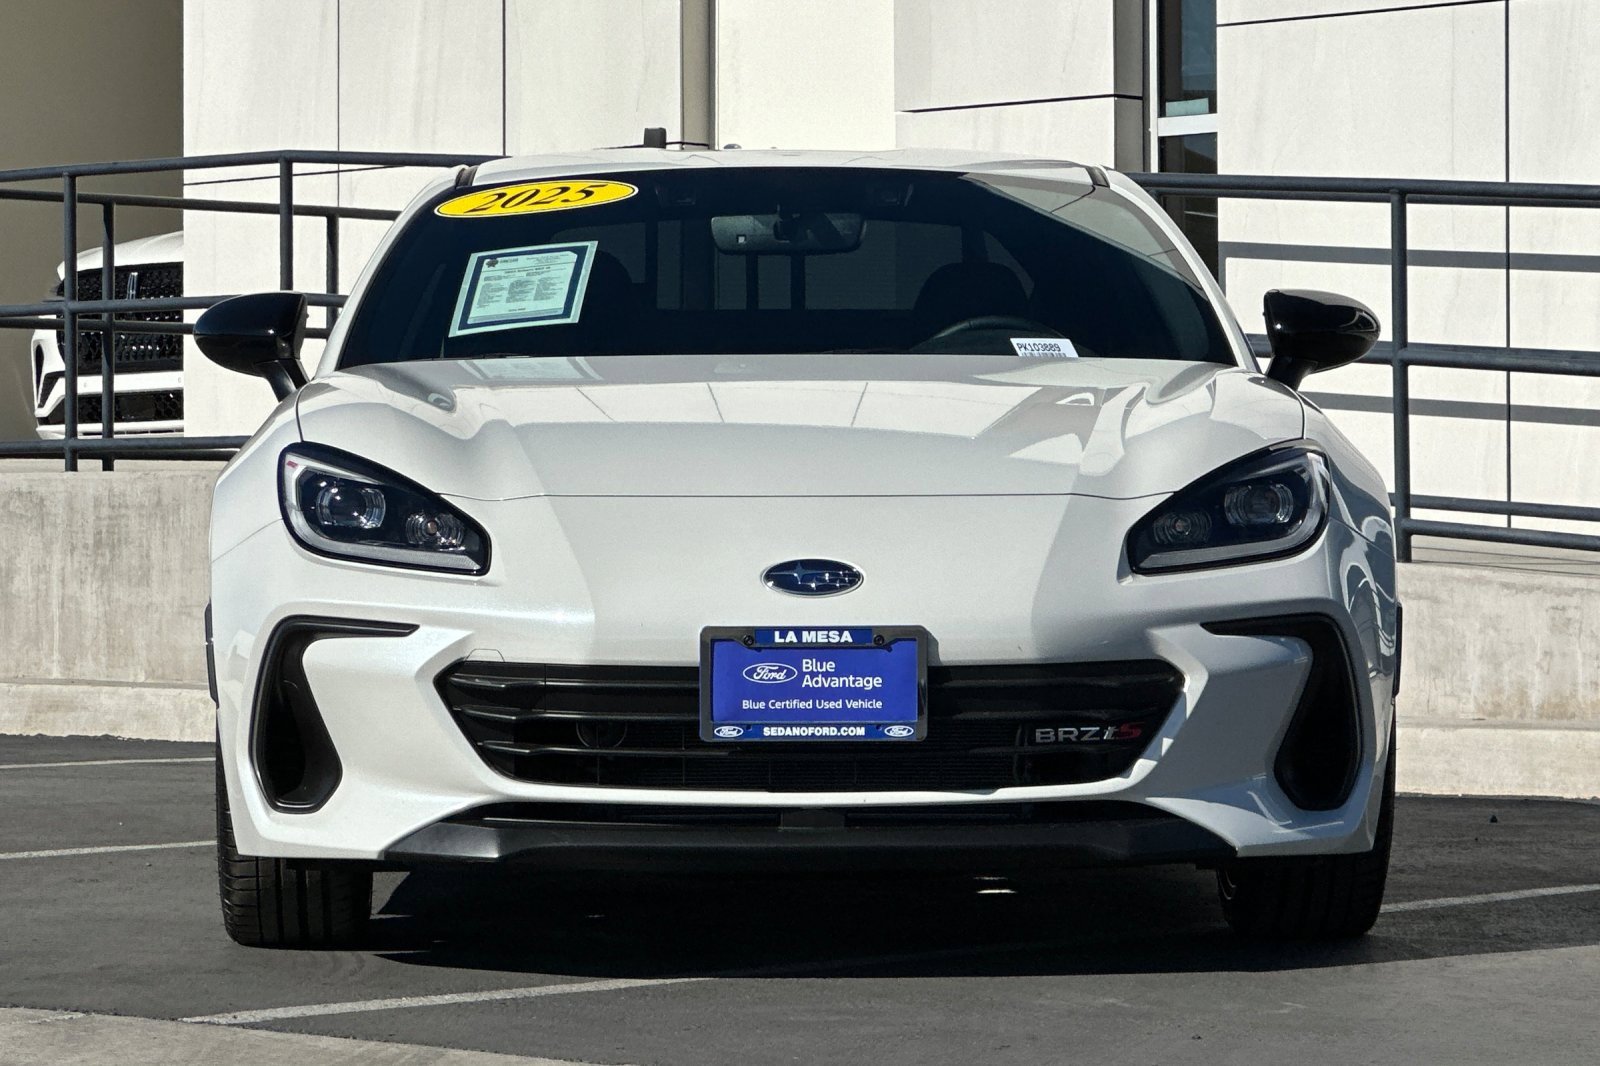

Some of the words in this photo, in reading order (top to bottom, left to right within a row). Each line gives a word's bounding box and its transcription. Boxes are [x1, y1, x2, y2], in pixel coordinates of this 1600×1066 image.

[464, 184, 608, 213] 2025
[773, 630, 798, 643] LA
[801, 630, 853, 643] MESA
[752, 665, 787, 681] Ford
[802, 658, 836, 673] Blue
[801, 674, 883, 691] Advantage
[742, 699, 766, 710] Blue
[768, 699, 813, 710] Certified
[815, 699, 843, 710] Used
[845, 699, 883, 710] Vehicle
[763, 726, 865, 737] SEDANOFORD.COM
